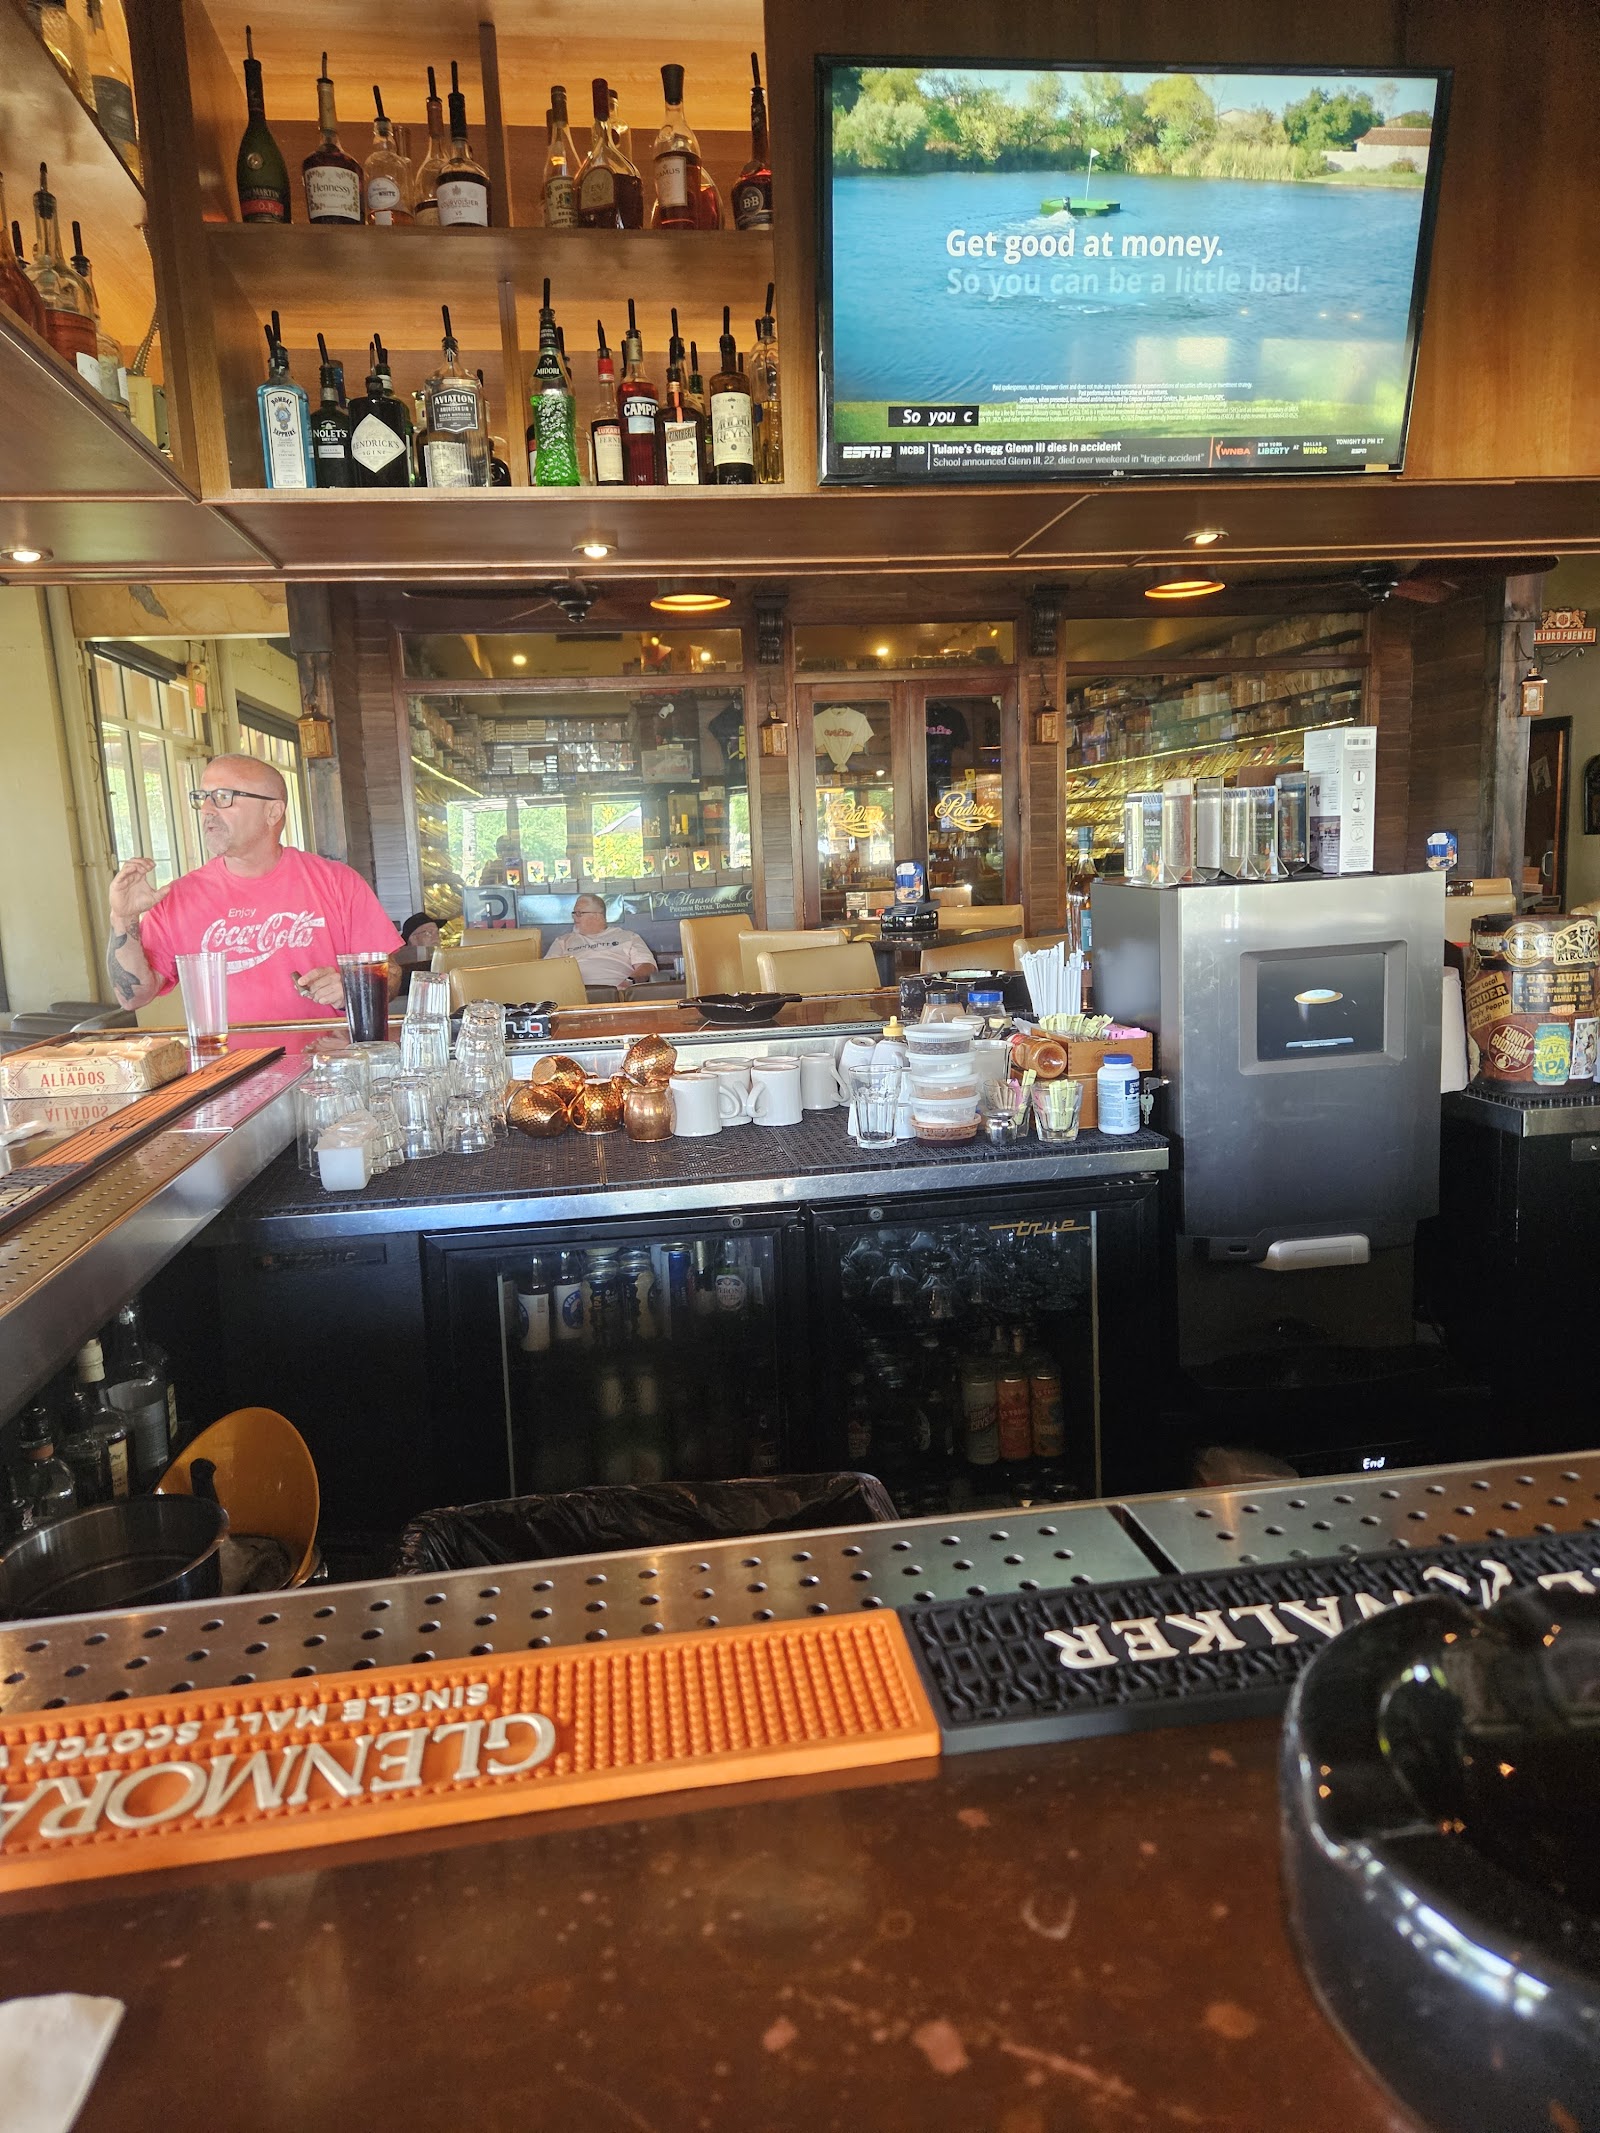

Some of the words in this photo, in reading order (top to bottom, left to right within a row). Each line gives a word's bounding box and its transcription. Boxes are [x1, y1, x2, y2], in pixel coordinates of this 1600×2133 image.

[313, 183, 351, 195] Hennessy
[945, 230, 996, 257] Get
[1004, 229, 1075, 265] good
[1083, 233, 1114, 257] at
[1122, 234, 1224, 265] money.
[946, 268, 980, 294] So
[988, 273, 1040, 302] you
[1049, 272, 1098, 294] can
[1109, 267, 1142, 294] be
[1151, 272, 1165, 294] a
[1175, 266, 1241, 294] little
[1251, 267, 1308, 294] bad.
[536, 367, 560, 375] MIDORI
[271, 397, 293, 407] BOMBAY
[434, 394, 474, 405] AVIATION
[903, 409, 921, 424] So
[928, 411, 955, 426] you
[963, 412, 973, 423] c
[273, 429, 297, 438] SAPPHIRE
[312, 429, 348, 438] NOLET'S
[353, 440, 400, 450] HENDRICK'S
[900, 446, 925, 455] MCBB
[932, 443, 972, 454] Tulane's
[974, 443, 1003, 456] Gregg
[1005, 443, 1030, 453] Glenn
[1031, 442, 1046, 453] III
[1048, 442, 1067, 453] dies
[1069, 442, 1078, 452] in
[1080, 441, 1122, 452] accident
[1257, 447, 1290, 455] LIBERTY
[1303, 446, 1328, 454] WINGS
[843, 446, 892, 459] ESPN2
[932, 457, 961, 467] School
[962, 456, 1007, 466] announced
[1008, 456, 1031, 466] Glenn
[1057, 455, 1075, 465] died
[1095, 454, 1130, 464] weekend
[1131, 455, 1139, 463] in
[1562, 630, 1593, 641] FUENTE
[228, 907, 257, 918] Enjoy
[669, 905, 694, 913] PREMIUM
[1481, 975, 1498, 988] Local
[1526, 974, 1554, 984] BAR
[1486, 999, 1510, 1011] People
[1502, 1026, 1532, 1048] FUNKY
[1491, 1034, 1526, 1061] BUDDHA
[1540, 1044, 1566, 1054] HAZY
[1538, 1058, 1566, 1073] IPA
[41, 1071, 106, 1088] ALIADOS
[1362, 1456, 1386, 1470] End
[342, 1683, 489, 1723] SINGLE
[215, 1703, 328, 1740] MALT
[25, 1721, 201, 1765] SCOTCH
